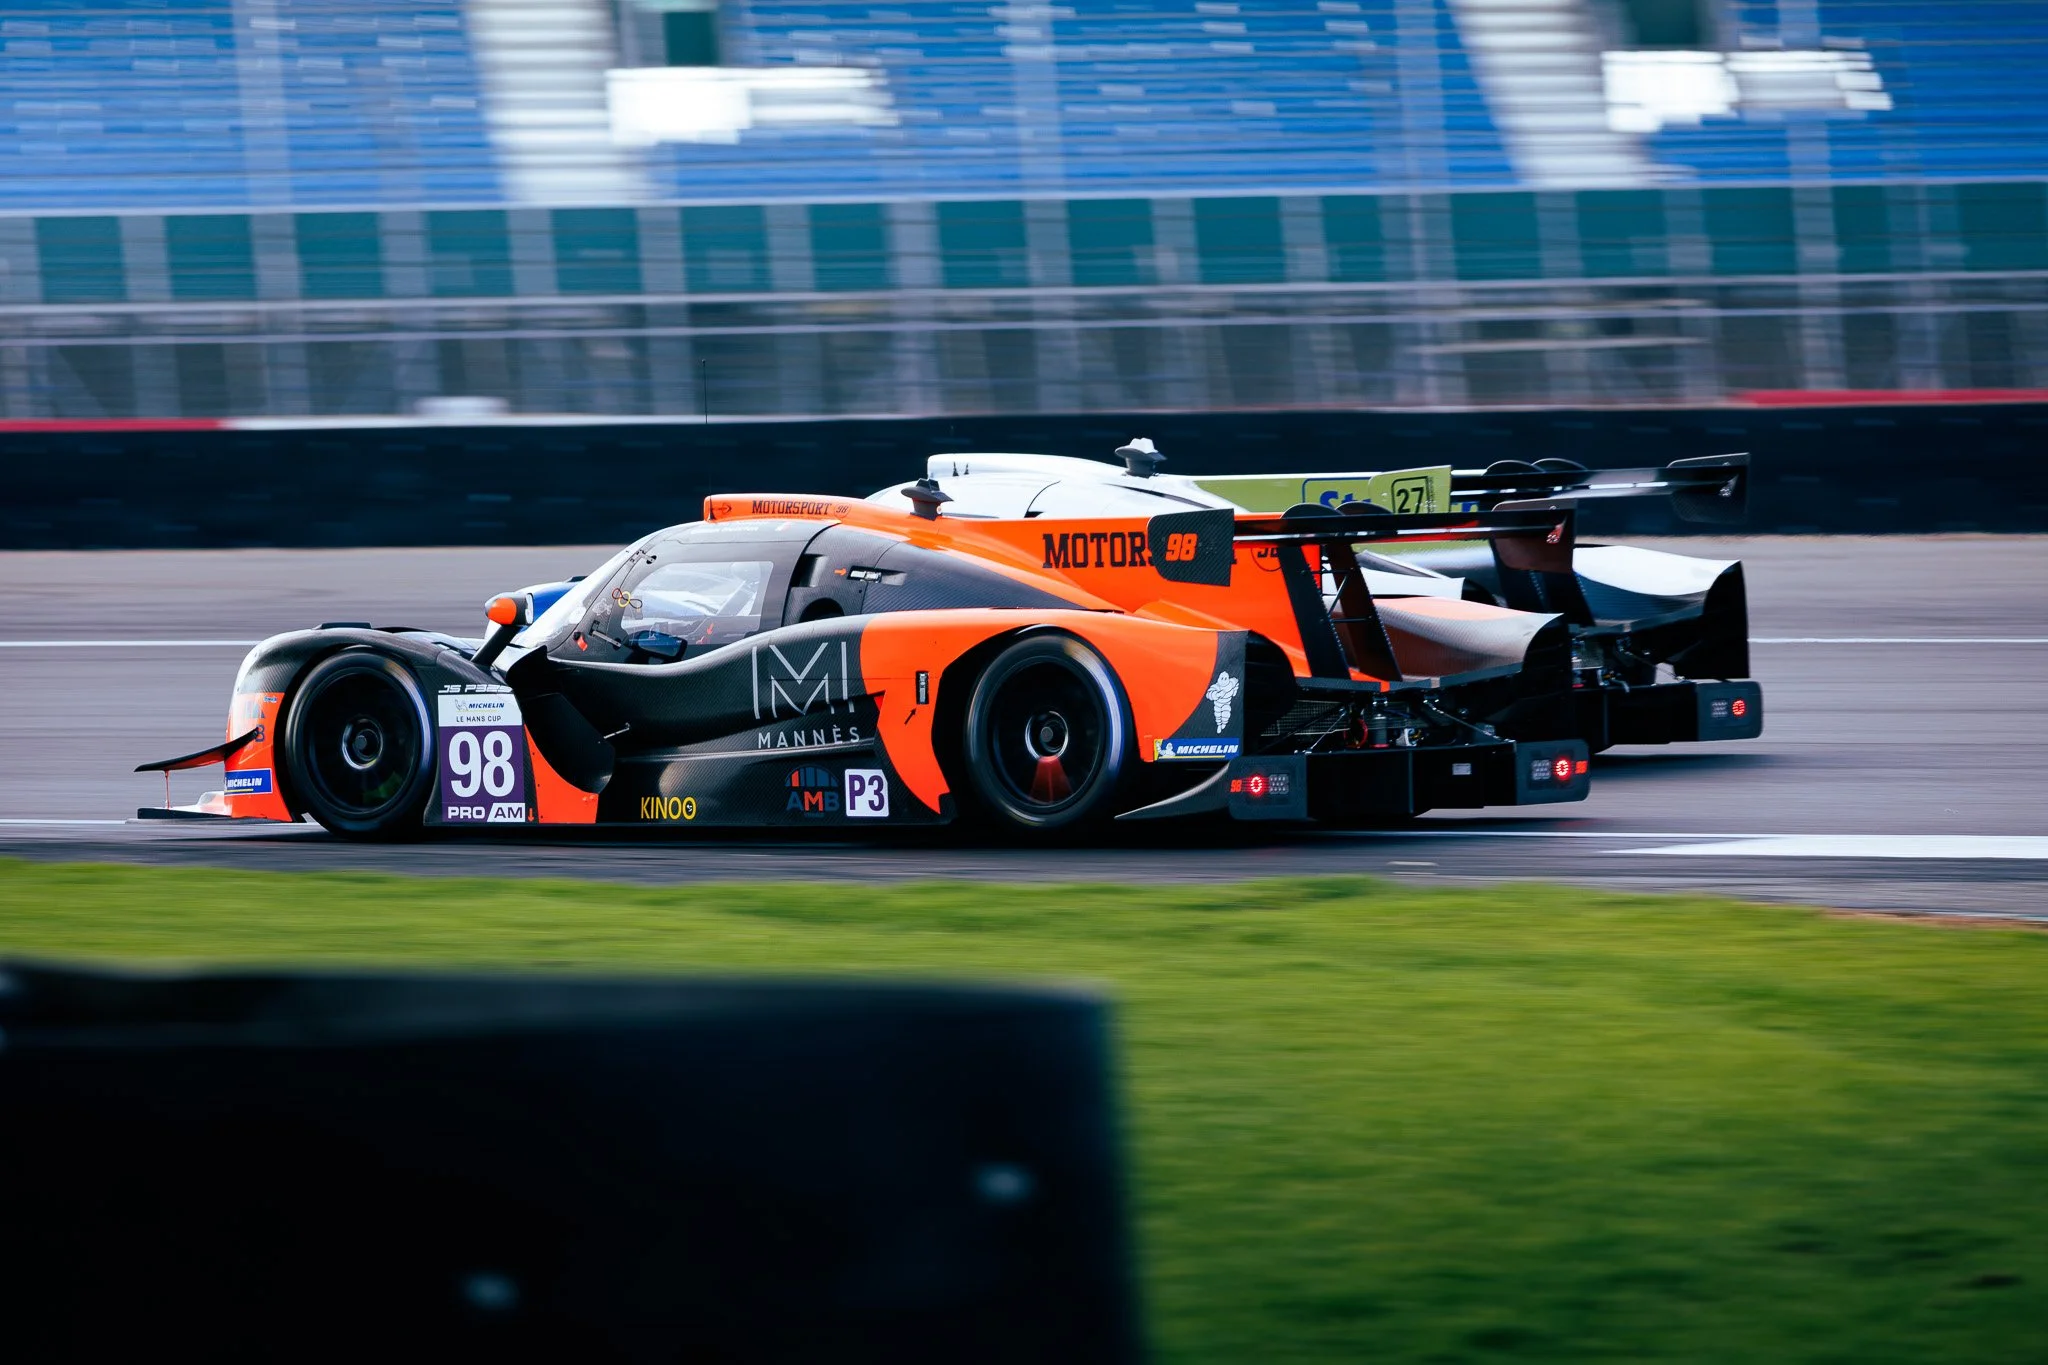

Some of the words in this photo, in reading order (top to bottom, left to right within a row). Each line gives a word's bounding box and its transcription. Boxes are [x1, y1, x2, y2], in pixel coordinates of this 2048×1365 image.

[752, 500, 831, 515] MOTORSPORT
[1396, 487, 1424, 513] 27
[1164, 533, 1198, 562] 98
[438, 685, 461, 694] JS
[758, 725, 860, 749] MANNÈS
[1176, 744, 1239, 755] MICHELIN
[448, 730, 515, 798] 98
[227, 778, 262, 788] MICHELIN
[848, 774, 885, 811] P3
[447, 806, 486, 819] PRO
[494, 806, 523, 819] AM
[640, 796, 697, 820] KINOO
[786, 791, 840, 812] AMB
